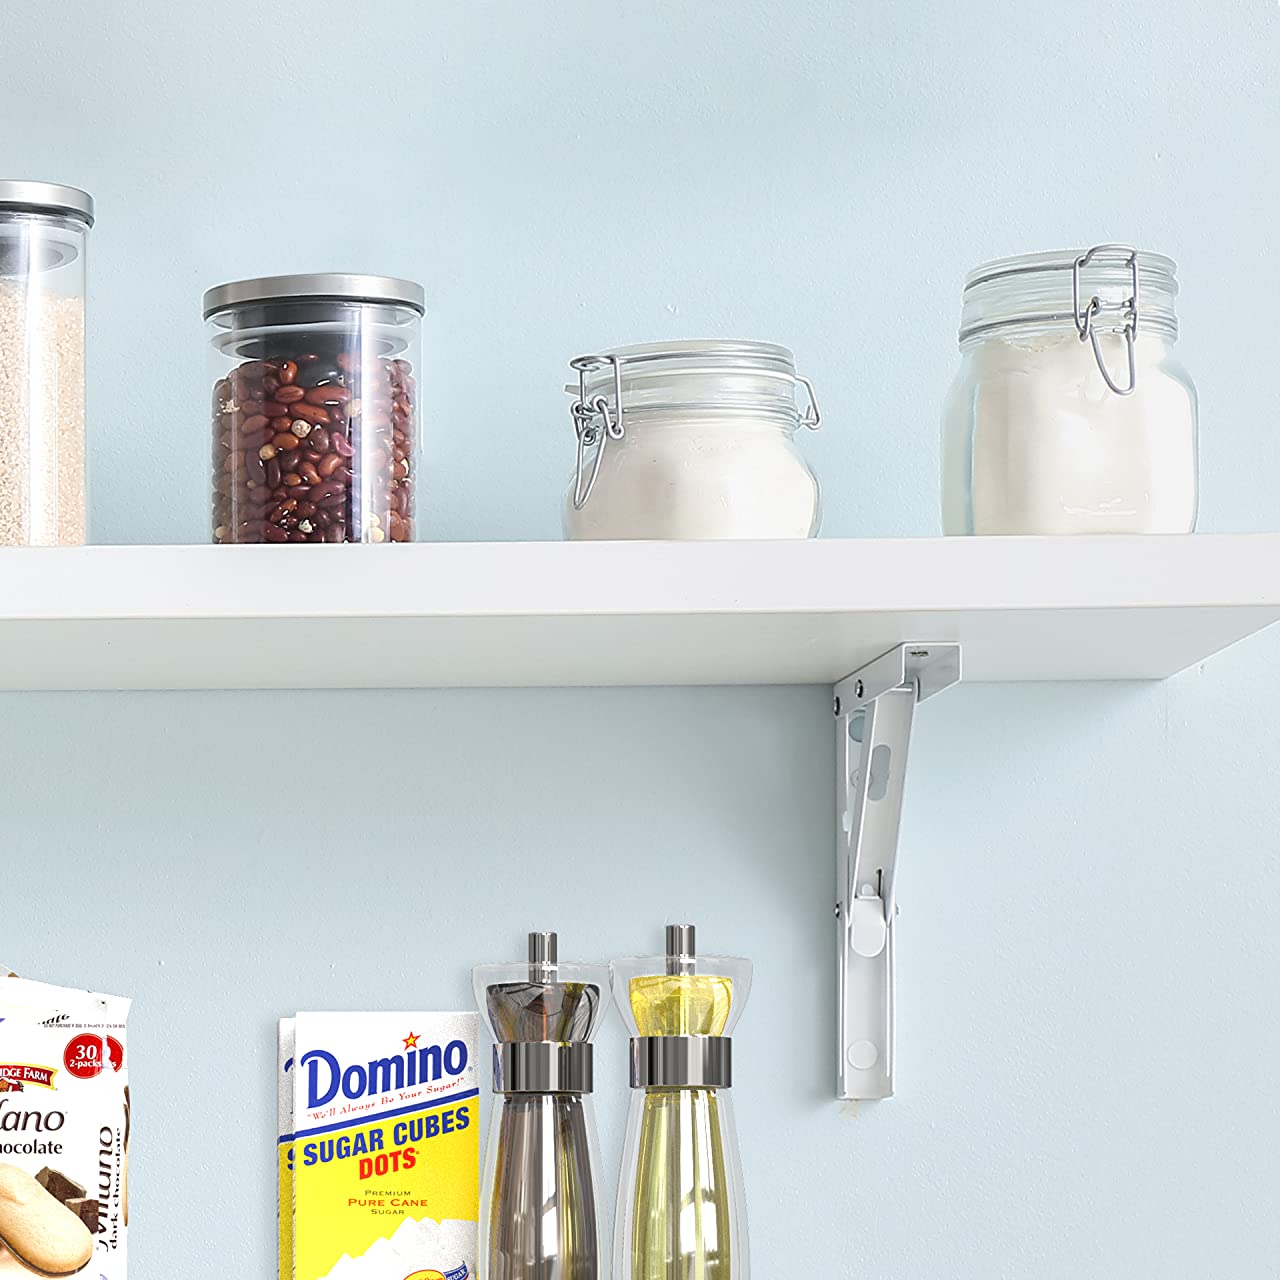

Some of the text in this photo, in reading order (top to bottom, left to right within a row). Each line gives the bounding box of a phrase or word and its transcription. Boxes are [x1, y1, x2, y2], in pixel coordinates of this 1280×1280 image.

[75, 1044, 98, 1060] 30
[23, 1067, 48, 1082] FARM
[69, 1060, 102, 1070] 2-packs
[300, 1039, 468, 1109] Domino
[340, 1102, 376, 1117] Always
[381, 1096, 394, 1105] Be
[398, 1090, 422, 1102] Your
[303, 1128, 384, 1166] SUGAR
[393, 1106, 470, 1146] CUBES
[359, 1147, 416, 1180] DOTS
[348, 1198, 428, 1207] PURE CANE
